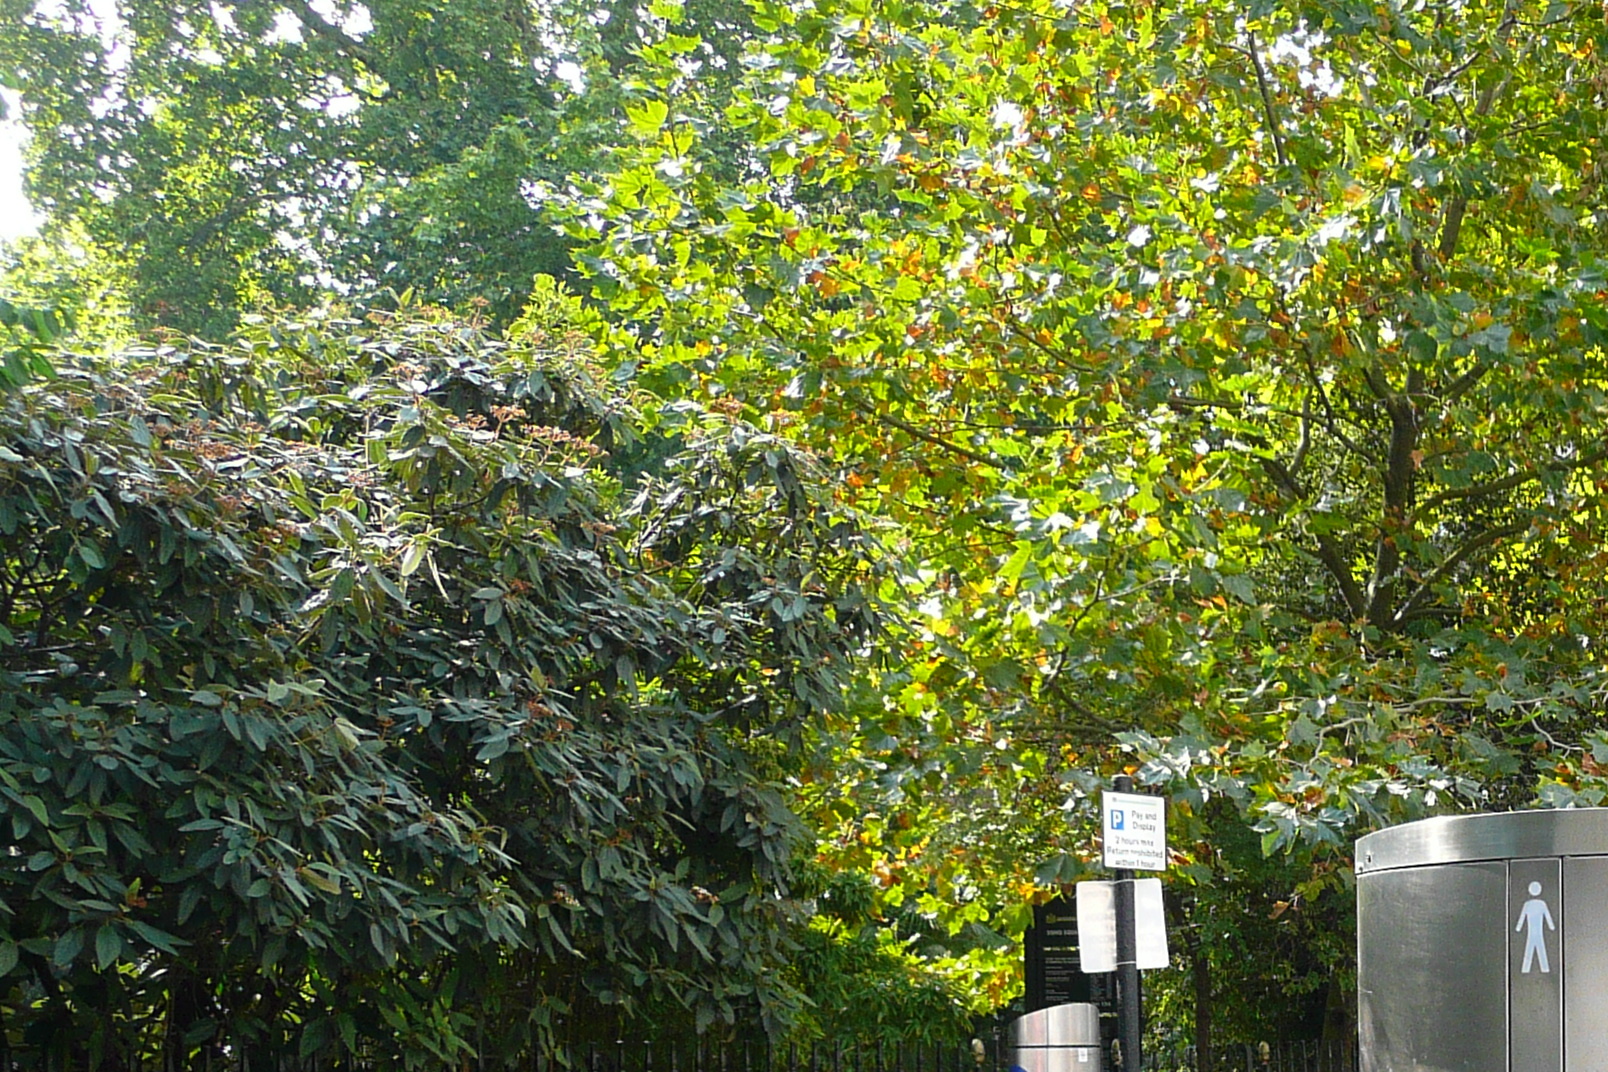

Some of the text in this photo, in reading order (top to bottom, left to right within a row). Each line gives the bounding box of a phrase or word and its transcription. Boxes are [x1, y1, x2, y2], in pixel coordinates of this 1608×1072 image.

[1132, 810, 1157, 820] Pay and
[1132, 821, 1156, 832] Display
[1121, 837, 1139, 846] hours
[1107, 846, 1129, 855] Return
